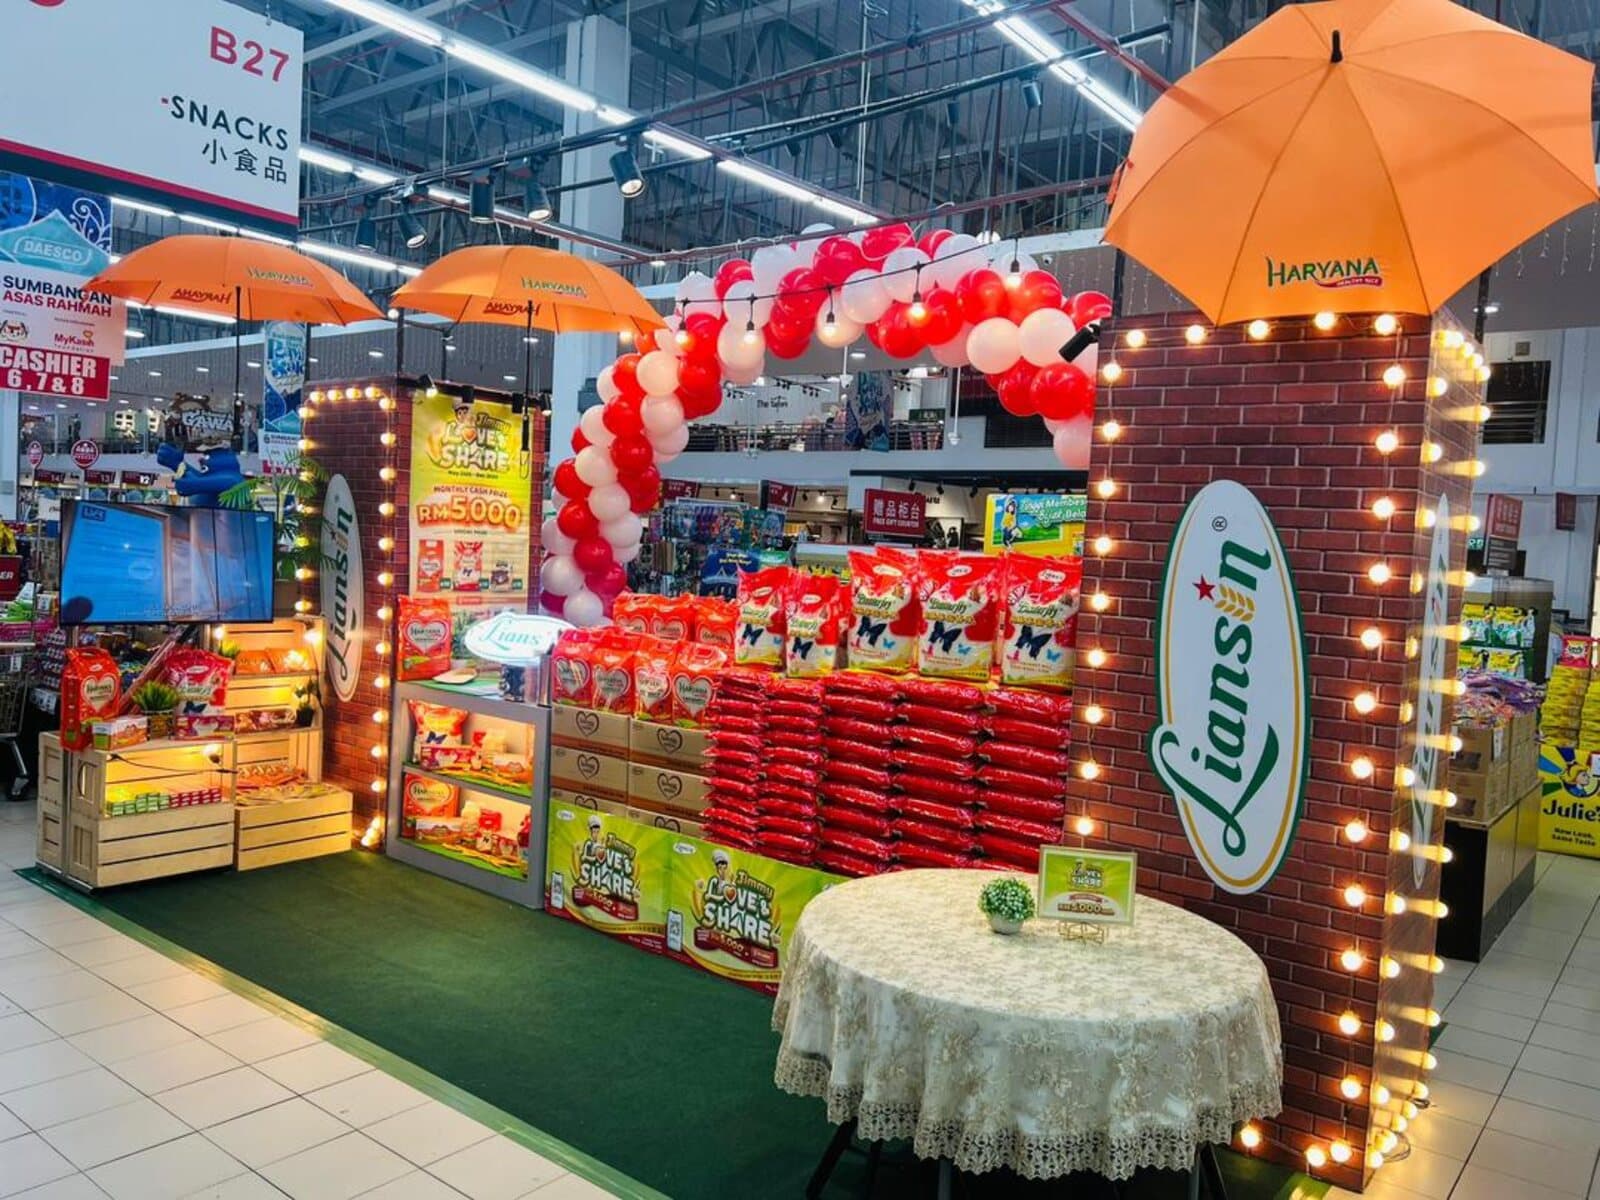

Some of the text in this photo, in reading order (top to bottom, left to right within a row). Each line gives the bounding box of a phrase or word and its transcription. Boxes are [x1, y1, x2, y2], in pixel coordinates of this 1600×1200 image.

[209, 26, 290, 82] B27
[202, 139, 287, 184] 小食品
[23, 240, 83, 261] DAESCO
[1265, 256, 1379, 287] HARYANA
[3, 275, 112, 305] SUMBANGAN
[3, 290, 112, 318] ASAS RAHMAH
[0, 346, 97, 378] CASHIER
[71, 377, 85, 395] 8
[1543, 799, 1600, 822] Julie'
[579, 864, 634, 900] SHARE
[737, 870, 773, 898] Jimmy
[702, 902, 771, 946] SHARE
